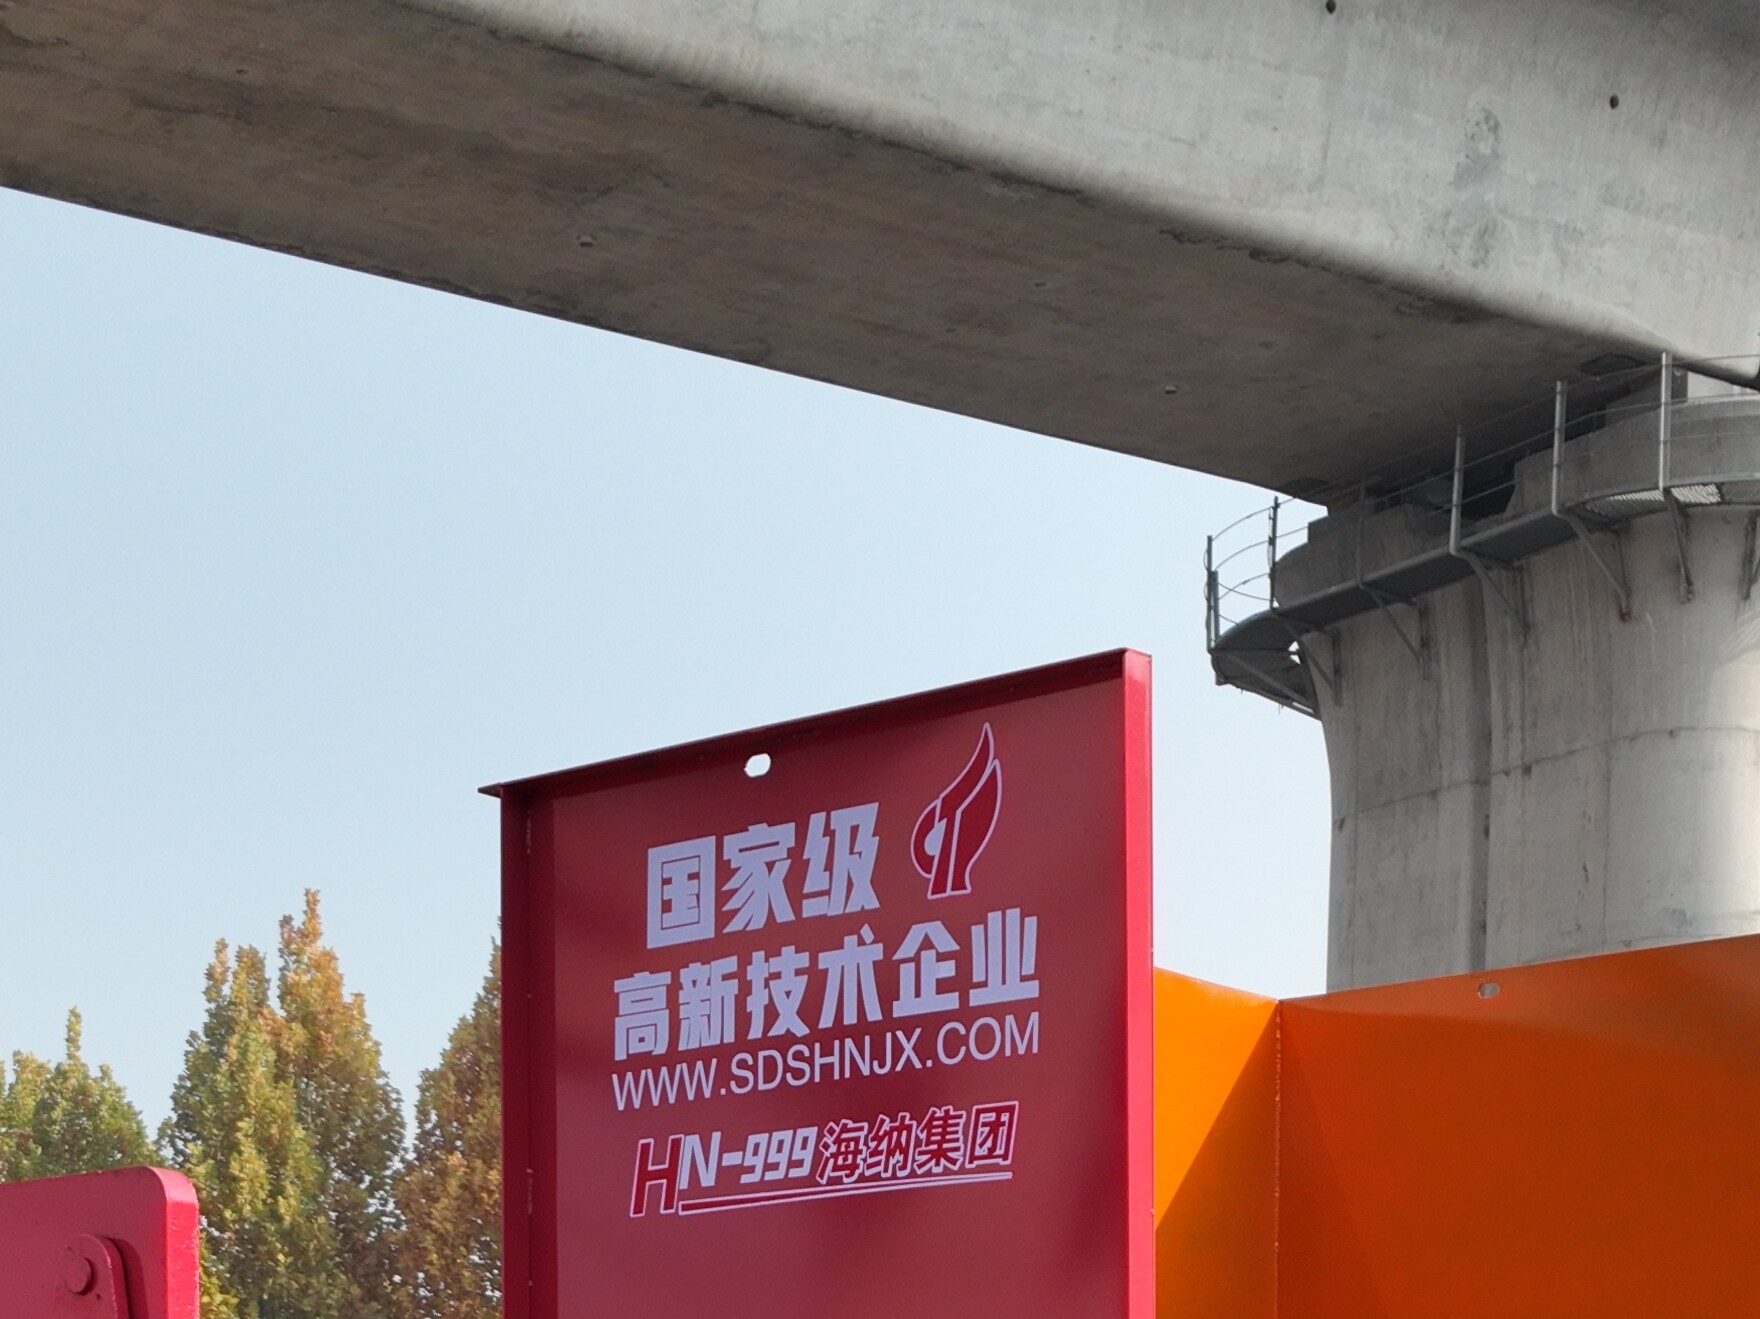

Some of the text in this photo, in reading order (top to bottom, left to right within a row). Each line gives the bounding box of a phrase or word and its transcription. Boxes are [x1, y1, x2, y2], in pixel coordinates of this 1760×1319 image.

[646, 801, 881, 950] 国家级
[613, 906, 1040, 1062] 高新技术企业
[611, 1011, 1040, 1111] WWW.SDSHNJX.COM
